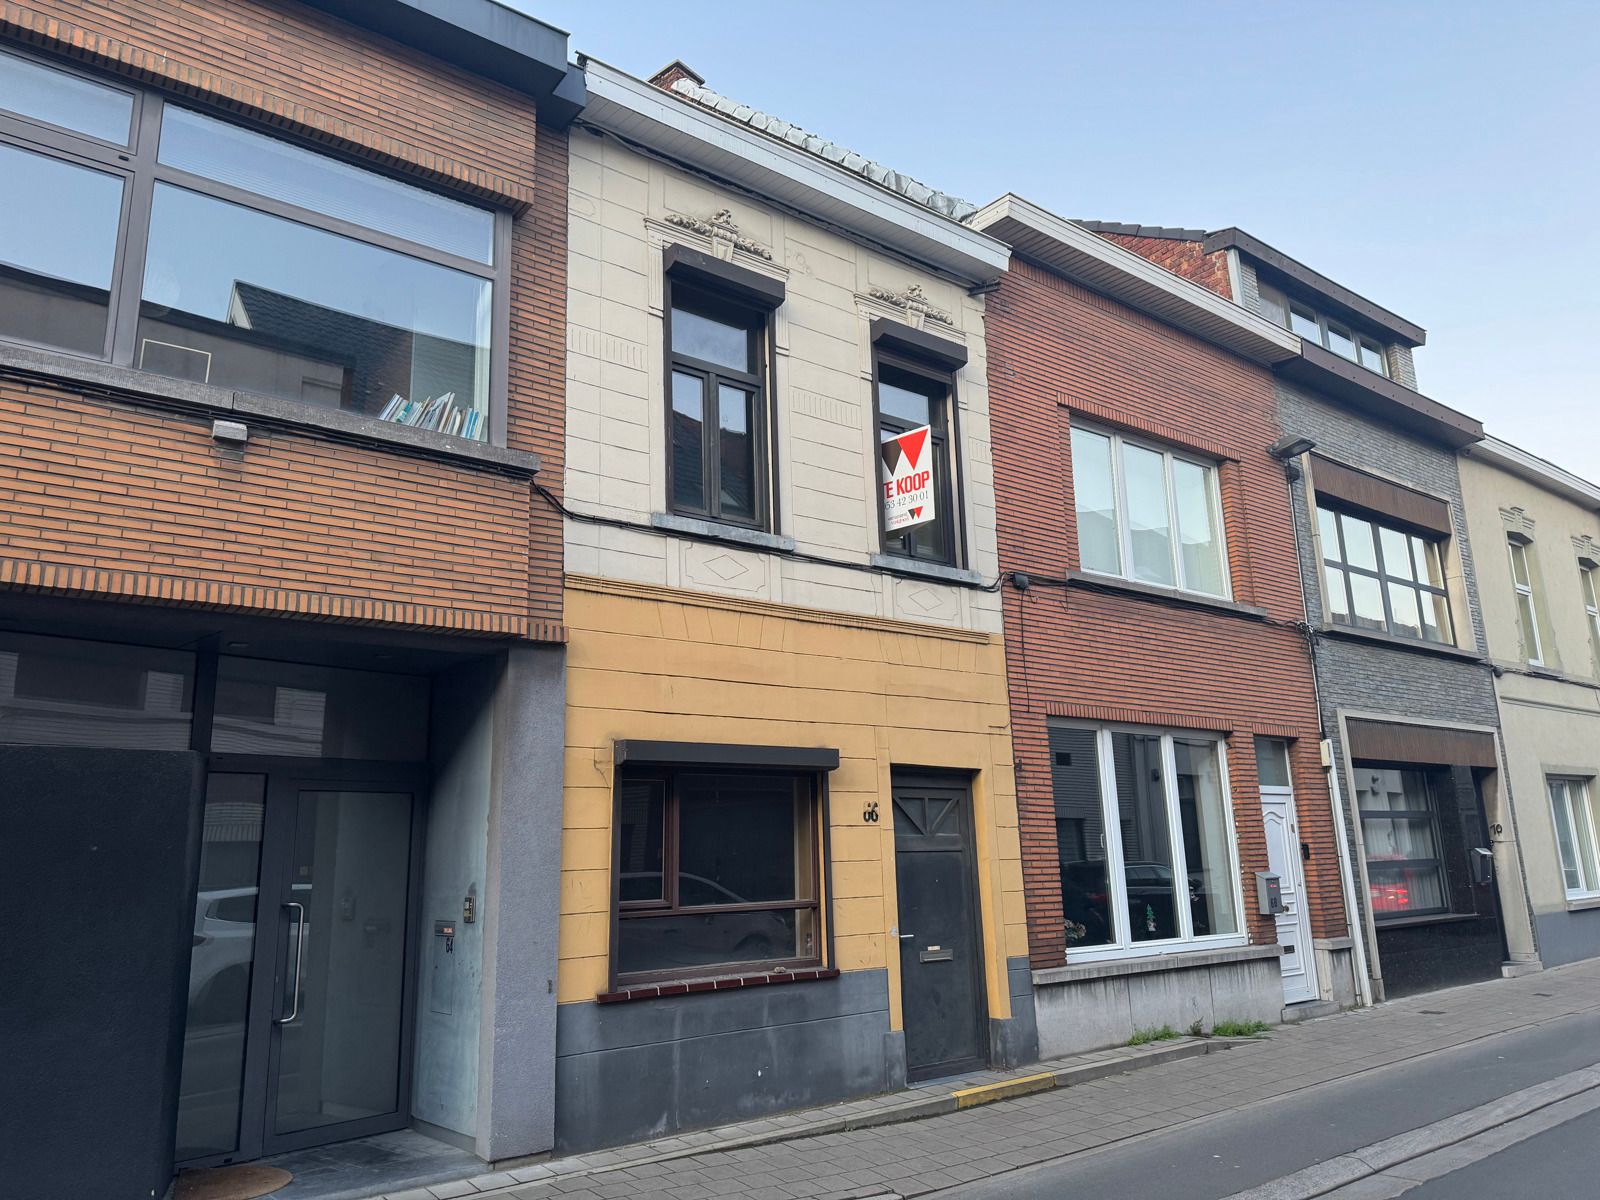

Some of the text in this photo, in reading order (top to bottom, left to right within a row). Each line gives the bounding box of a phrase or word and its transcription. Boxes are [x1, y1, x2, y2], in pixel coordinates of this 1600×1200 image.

[896, 470, 930, 496] KOOP
[897, 496, 906, 507] 42
[908, 493, 918, 504] 30
[919, 490, 928, 501] 01
[863, 800, 879, 823] 66
[1489, 823, 1503, 836] 70
[445, 937, 454, 954] 64
